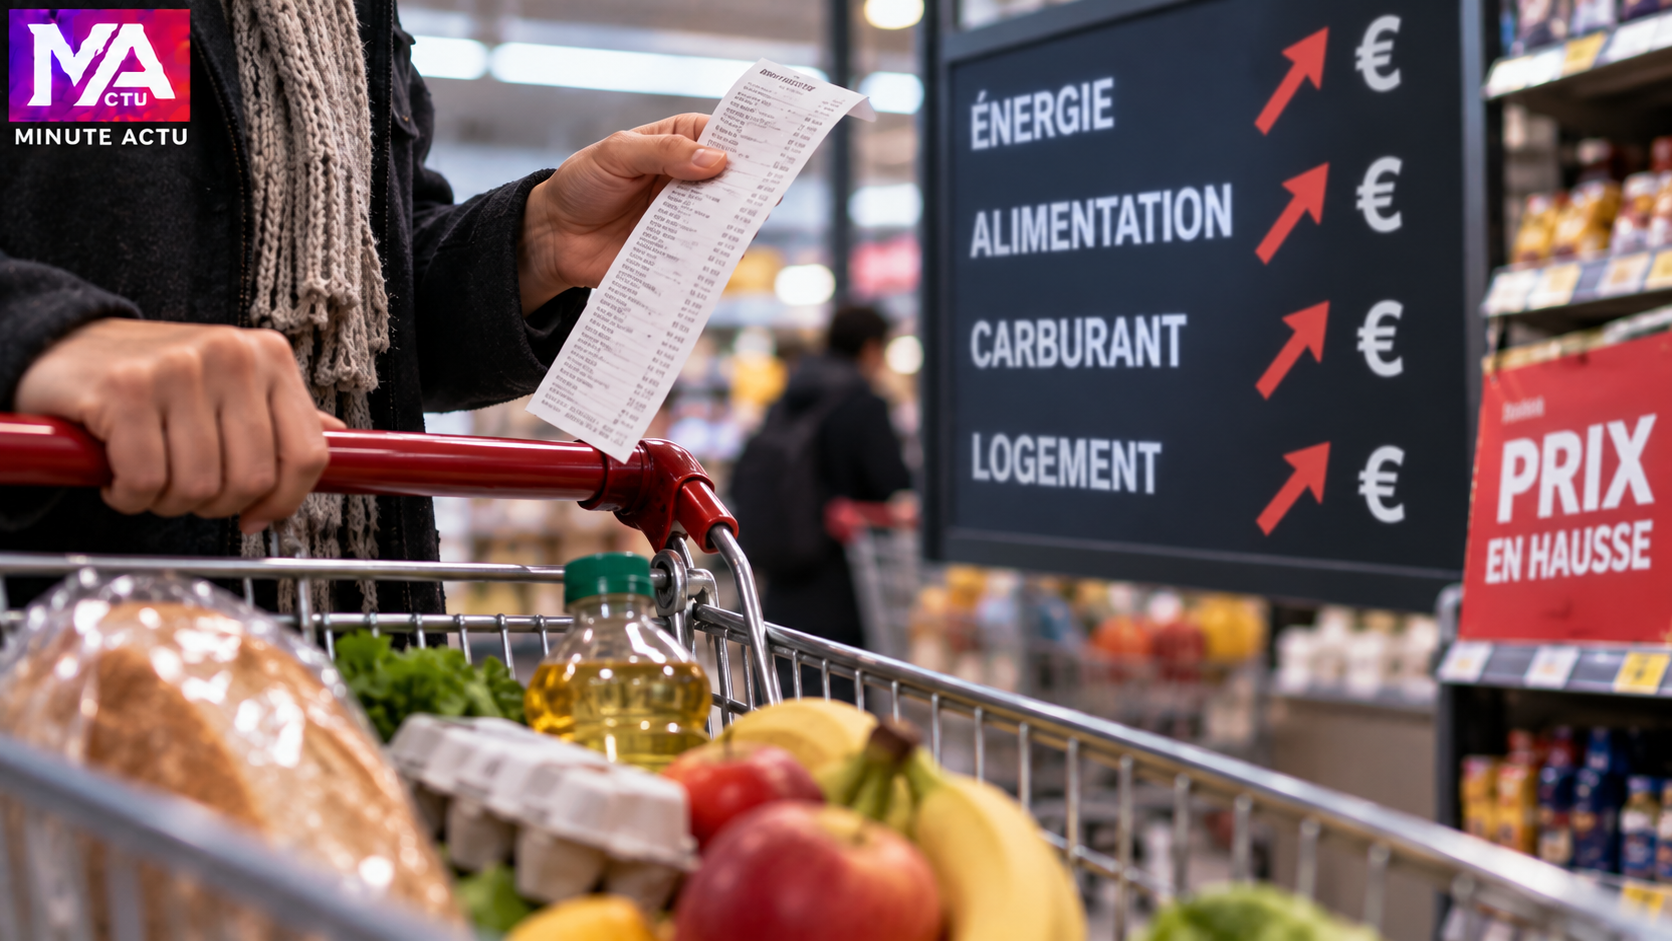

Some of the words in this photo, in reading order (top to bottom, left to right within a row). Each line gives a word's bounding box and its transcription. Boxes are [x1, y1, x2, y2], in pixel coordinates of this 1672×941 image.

[971, 77, 1114, 150] ÉNERGIE
[1355, 15, 1401, 92] €
[970, 183, 1232, 258] ALIMENTATION
[1356, 156, 1402, 233] €
[970, 313, 1187, 369] CARBURANT
[1357, 299, 1403, 377] €
[972, 432, 1161, 495] LOGEMENT
[1358, 445, 1405, 523] €
[1496, 413, 1657, 524] PRIX
[1485, 535, 1523, 584] EN
[1528, 519, 1653, 580] HAUSSE
